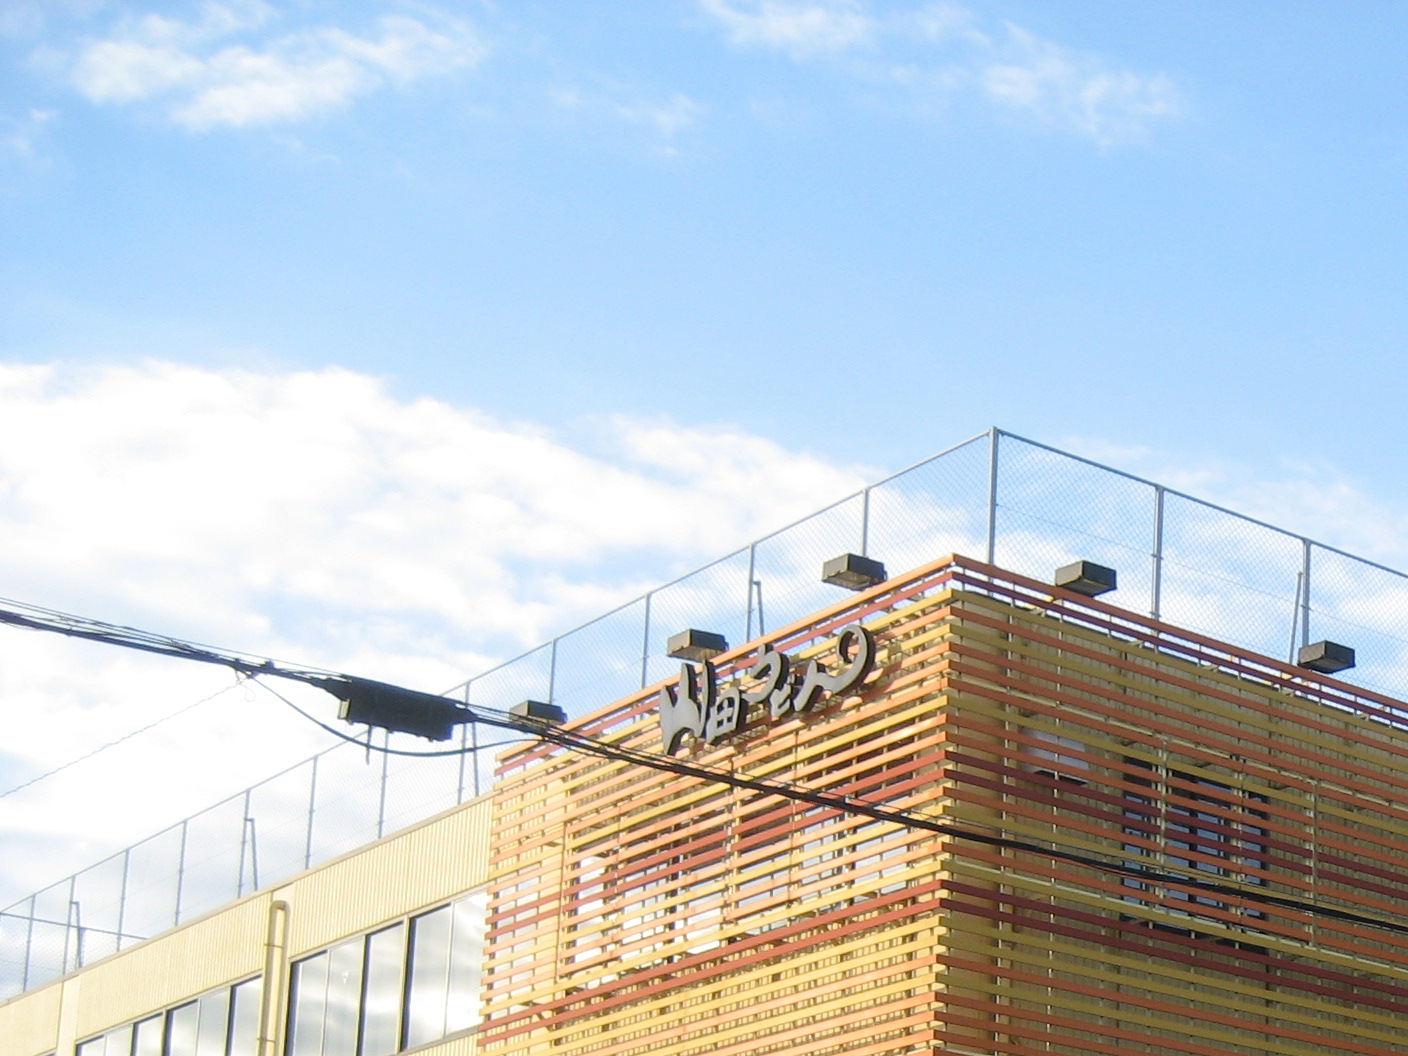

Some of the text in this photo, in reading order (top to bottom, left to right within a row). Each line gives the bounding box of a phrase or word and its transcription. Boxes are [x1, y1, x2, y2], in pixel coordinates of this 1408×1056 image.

[660, 624, 876, 755] 山田うどん
